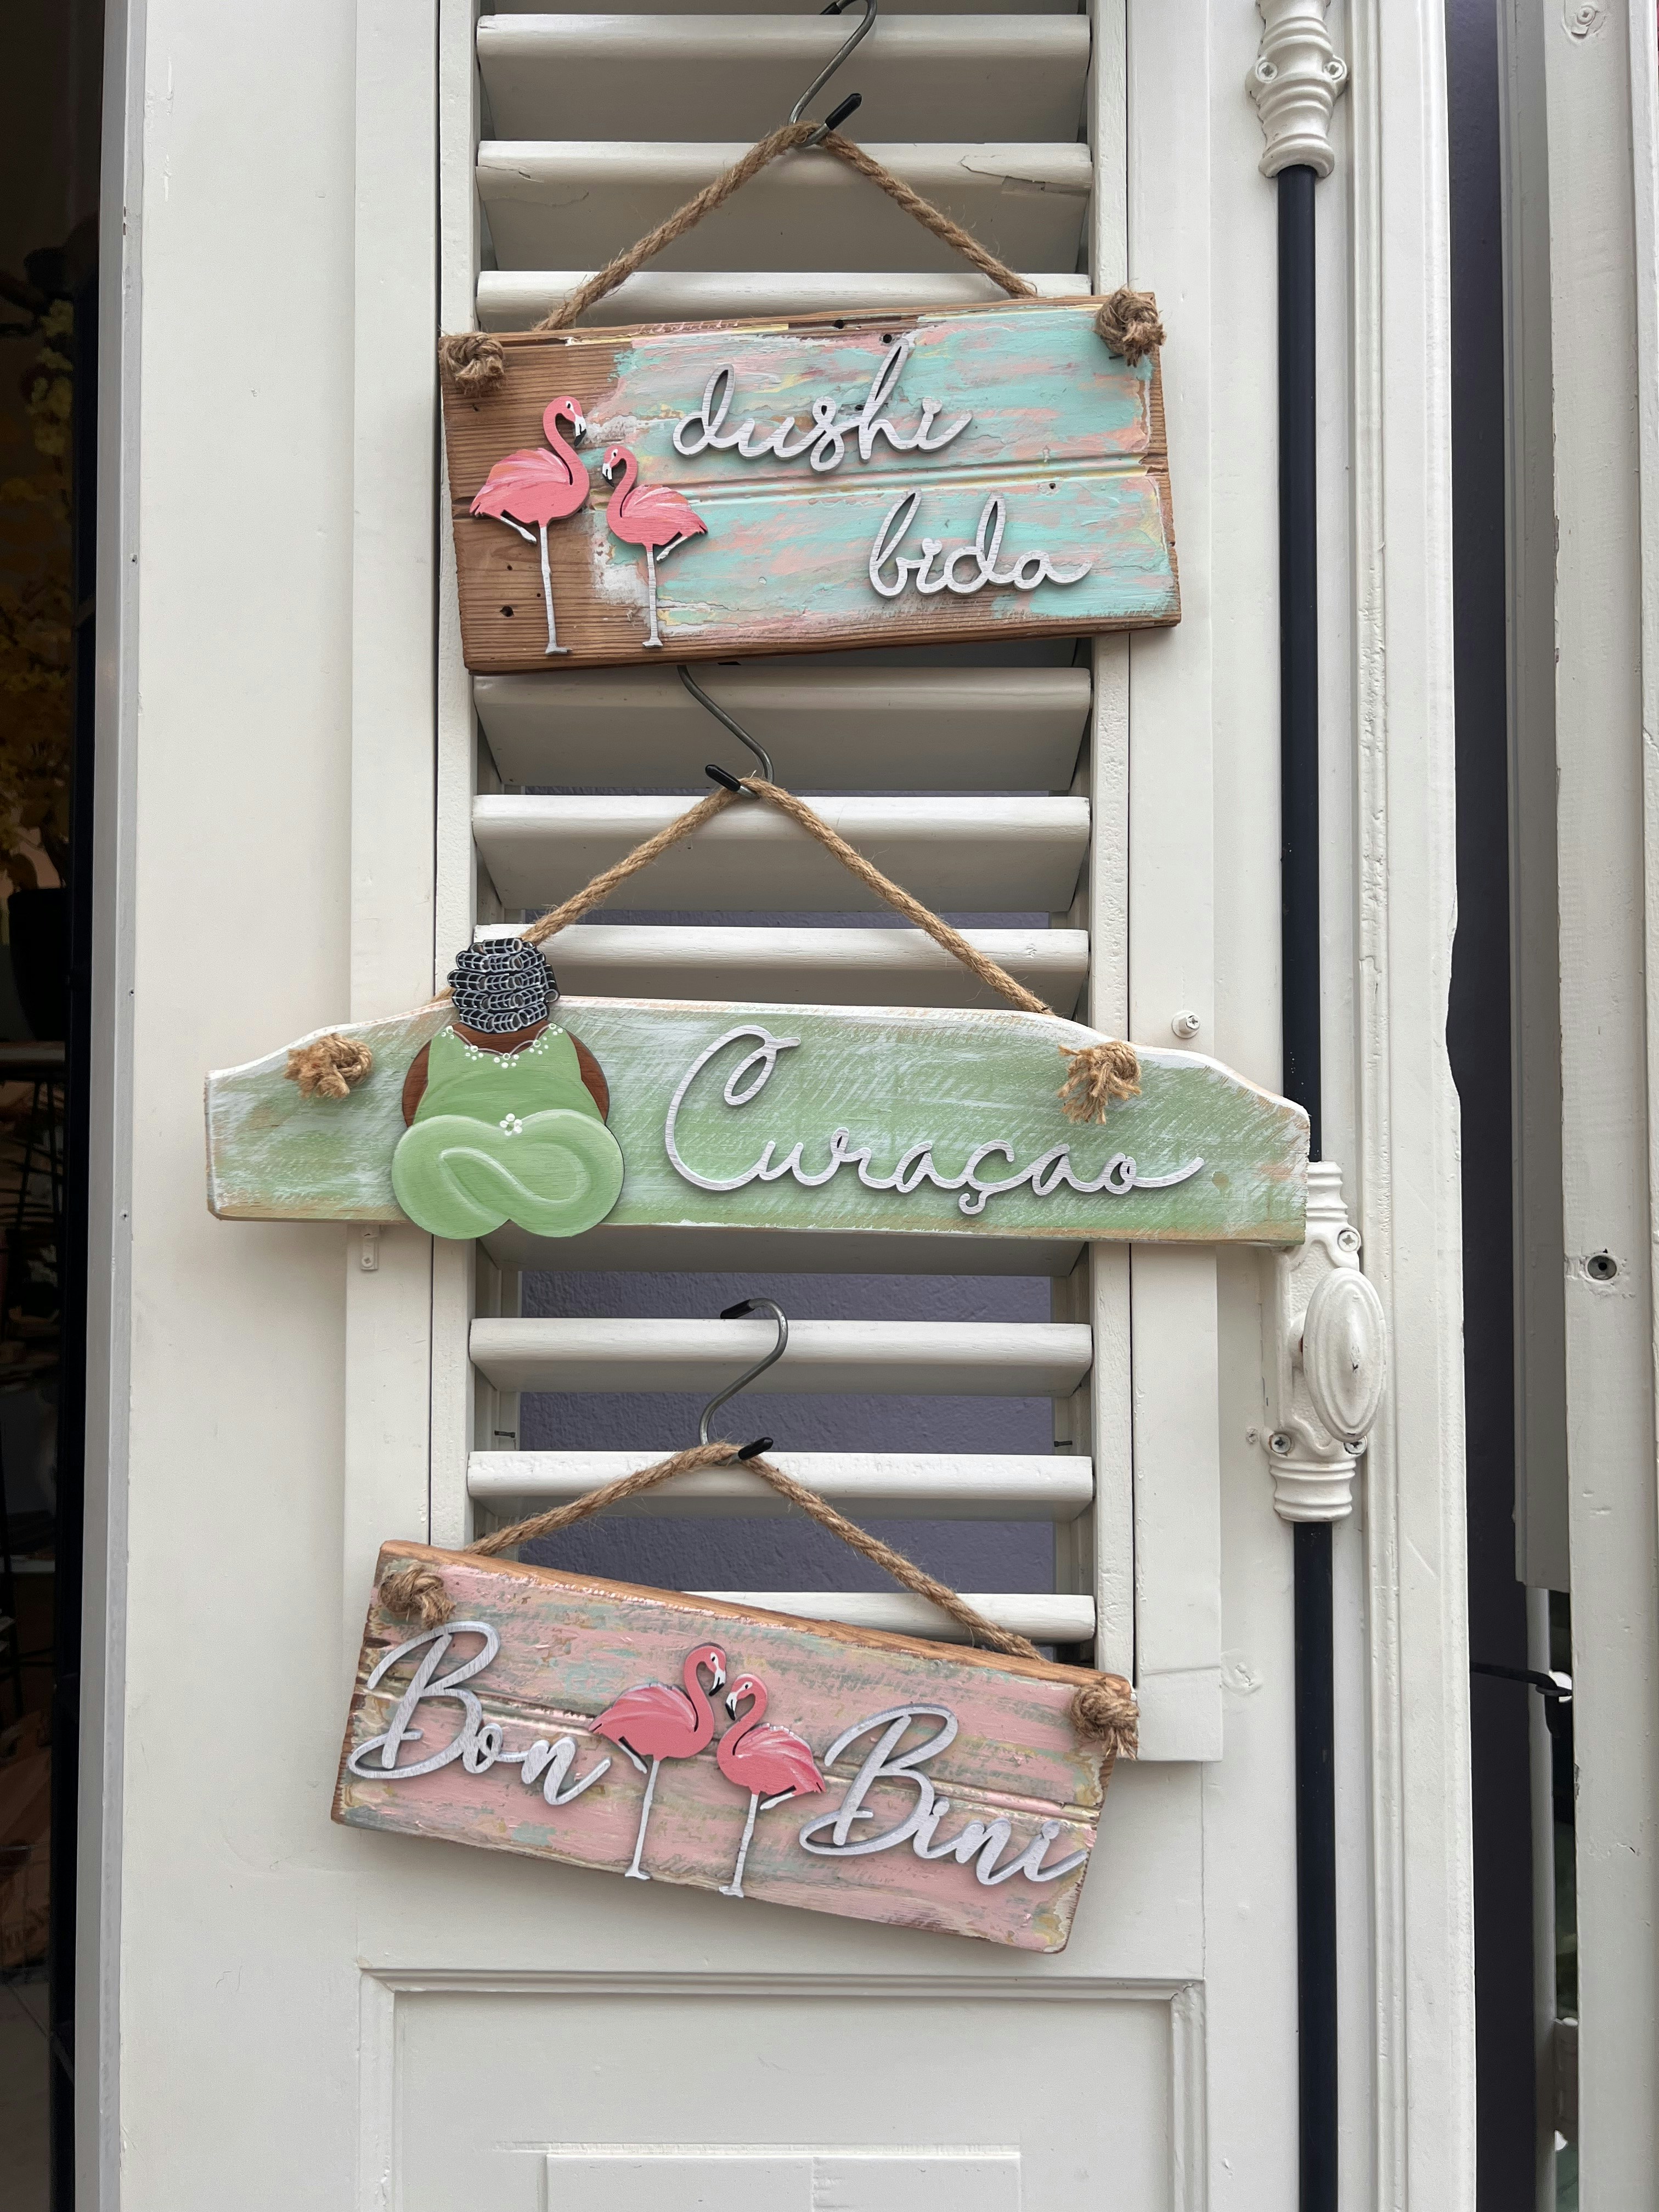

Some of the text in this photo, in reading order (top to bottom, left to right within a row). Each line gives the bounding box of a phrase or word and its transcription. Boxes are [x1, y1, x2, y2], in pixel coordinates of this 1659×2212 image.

[673, 338, 973, 473] dushi
[868, 487, 1092, 599] bida
[664, 1025, 1205, 1215] Curaçao
[347, 1621, 1089, 1886] Bon Bini
